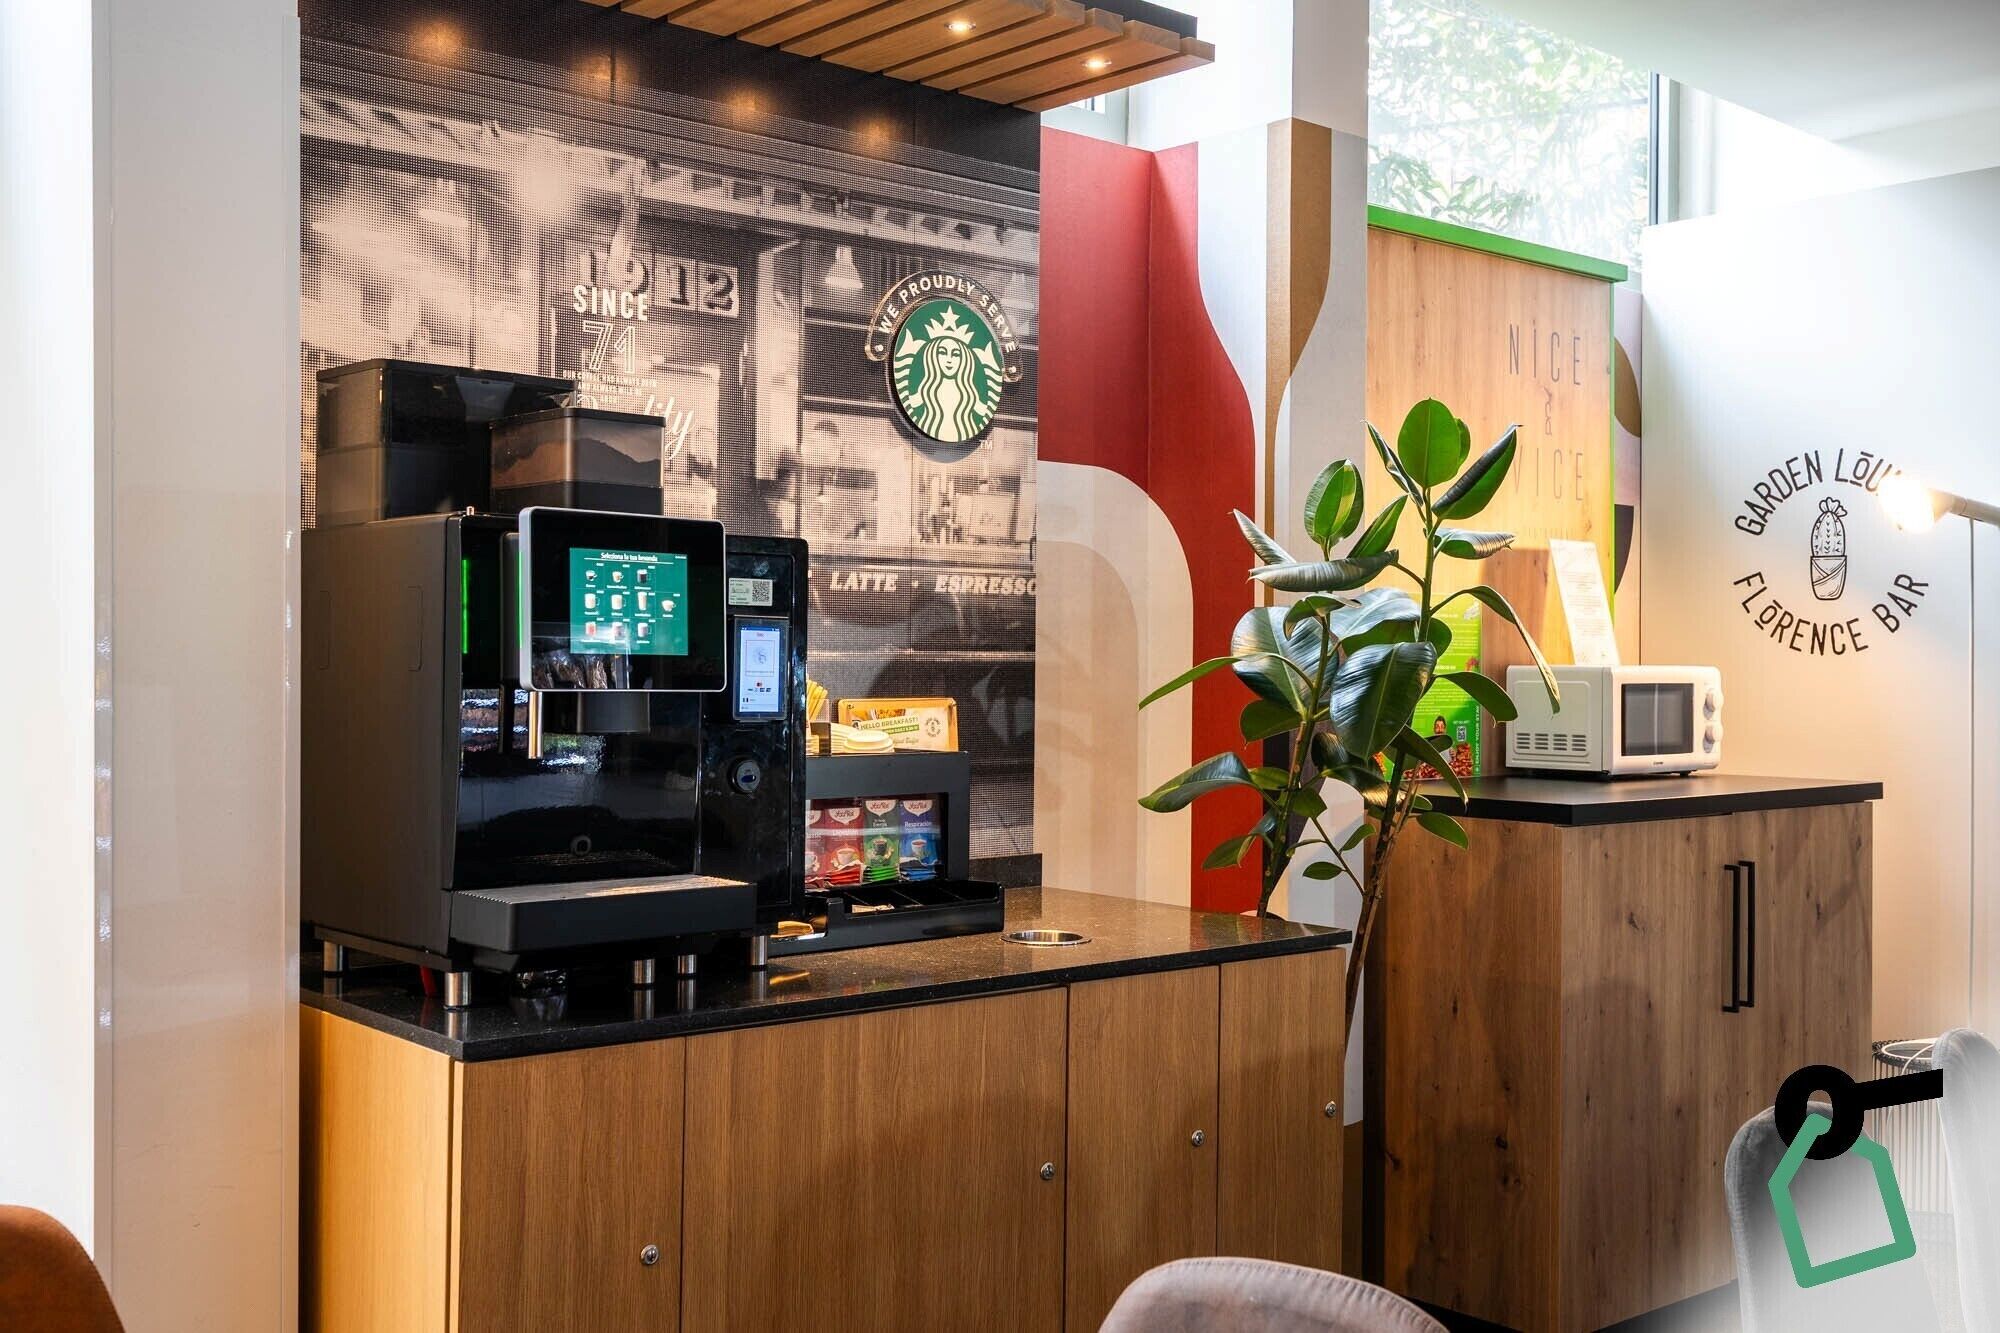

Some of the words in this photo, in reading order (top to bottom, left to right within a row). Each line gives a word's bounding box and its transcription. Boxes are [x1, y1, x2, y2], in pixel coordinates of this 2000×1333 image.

[573, 285, 648, 321] SINCE
[880, 305, 899, 334] WE
[899, 275, 975, 304] PROUDLY
[980, 295, 1016, 353] SERVE
[583, 320, 635, 374] 71
[1513, 445, 1583, 500] VICE
[1735, 450, 1823, 536] GARDEN
[830, 571, 898, 592] LATTE
[935, 575, 1036, 595] ESPRESSO
[1872, 573, 1929, 633] BAR
